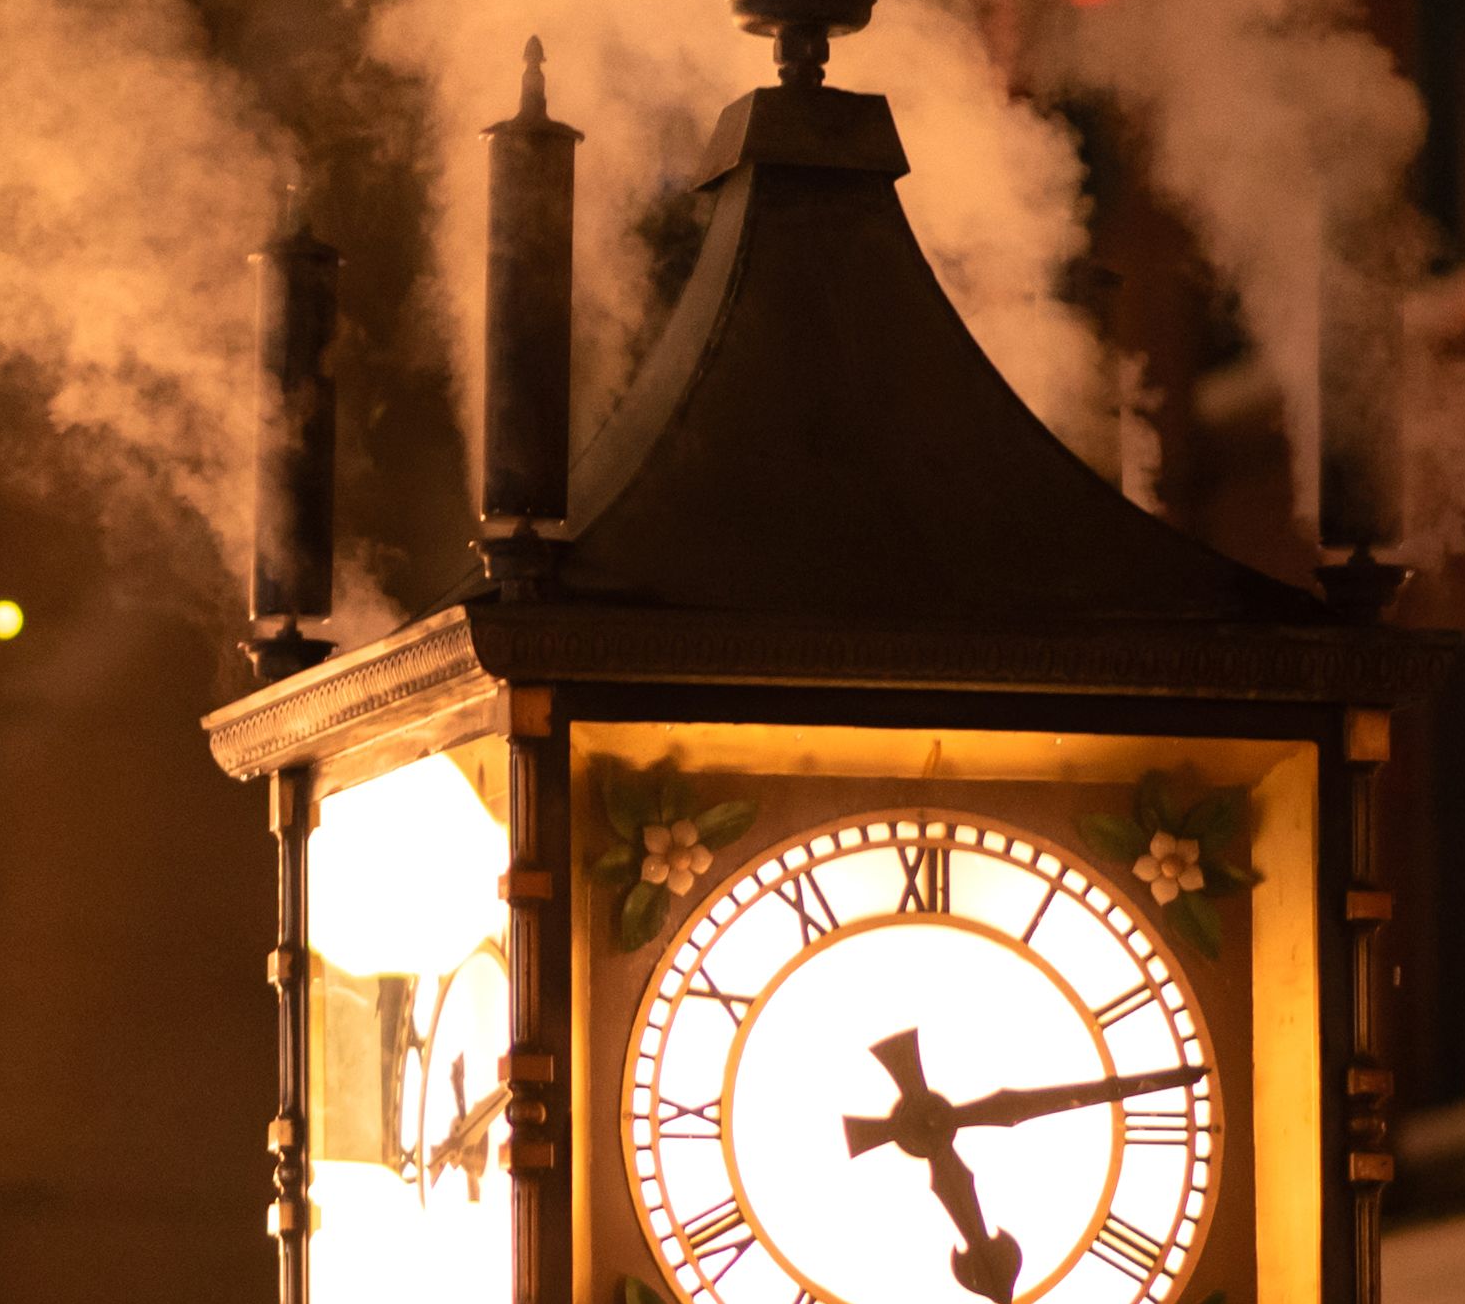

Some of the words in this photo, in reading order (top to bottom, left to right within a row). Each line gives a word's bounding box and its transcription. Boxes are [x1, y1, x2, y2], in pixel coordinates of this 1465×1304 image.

[773, 871, 840, 947] XI
[895, 846, 950, 914] XII
[1022, 884, 1058, 947] I
[685, 964, 756, 1029] X
[1094, 983, 1159, 1030] II
[659, 1096, 722, 1140] IX
[1124, 1111, 1189, 1146] III
[681, 1197, 757, 1285] VIII
[1087, 1211, 1164, 1284] IIII
